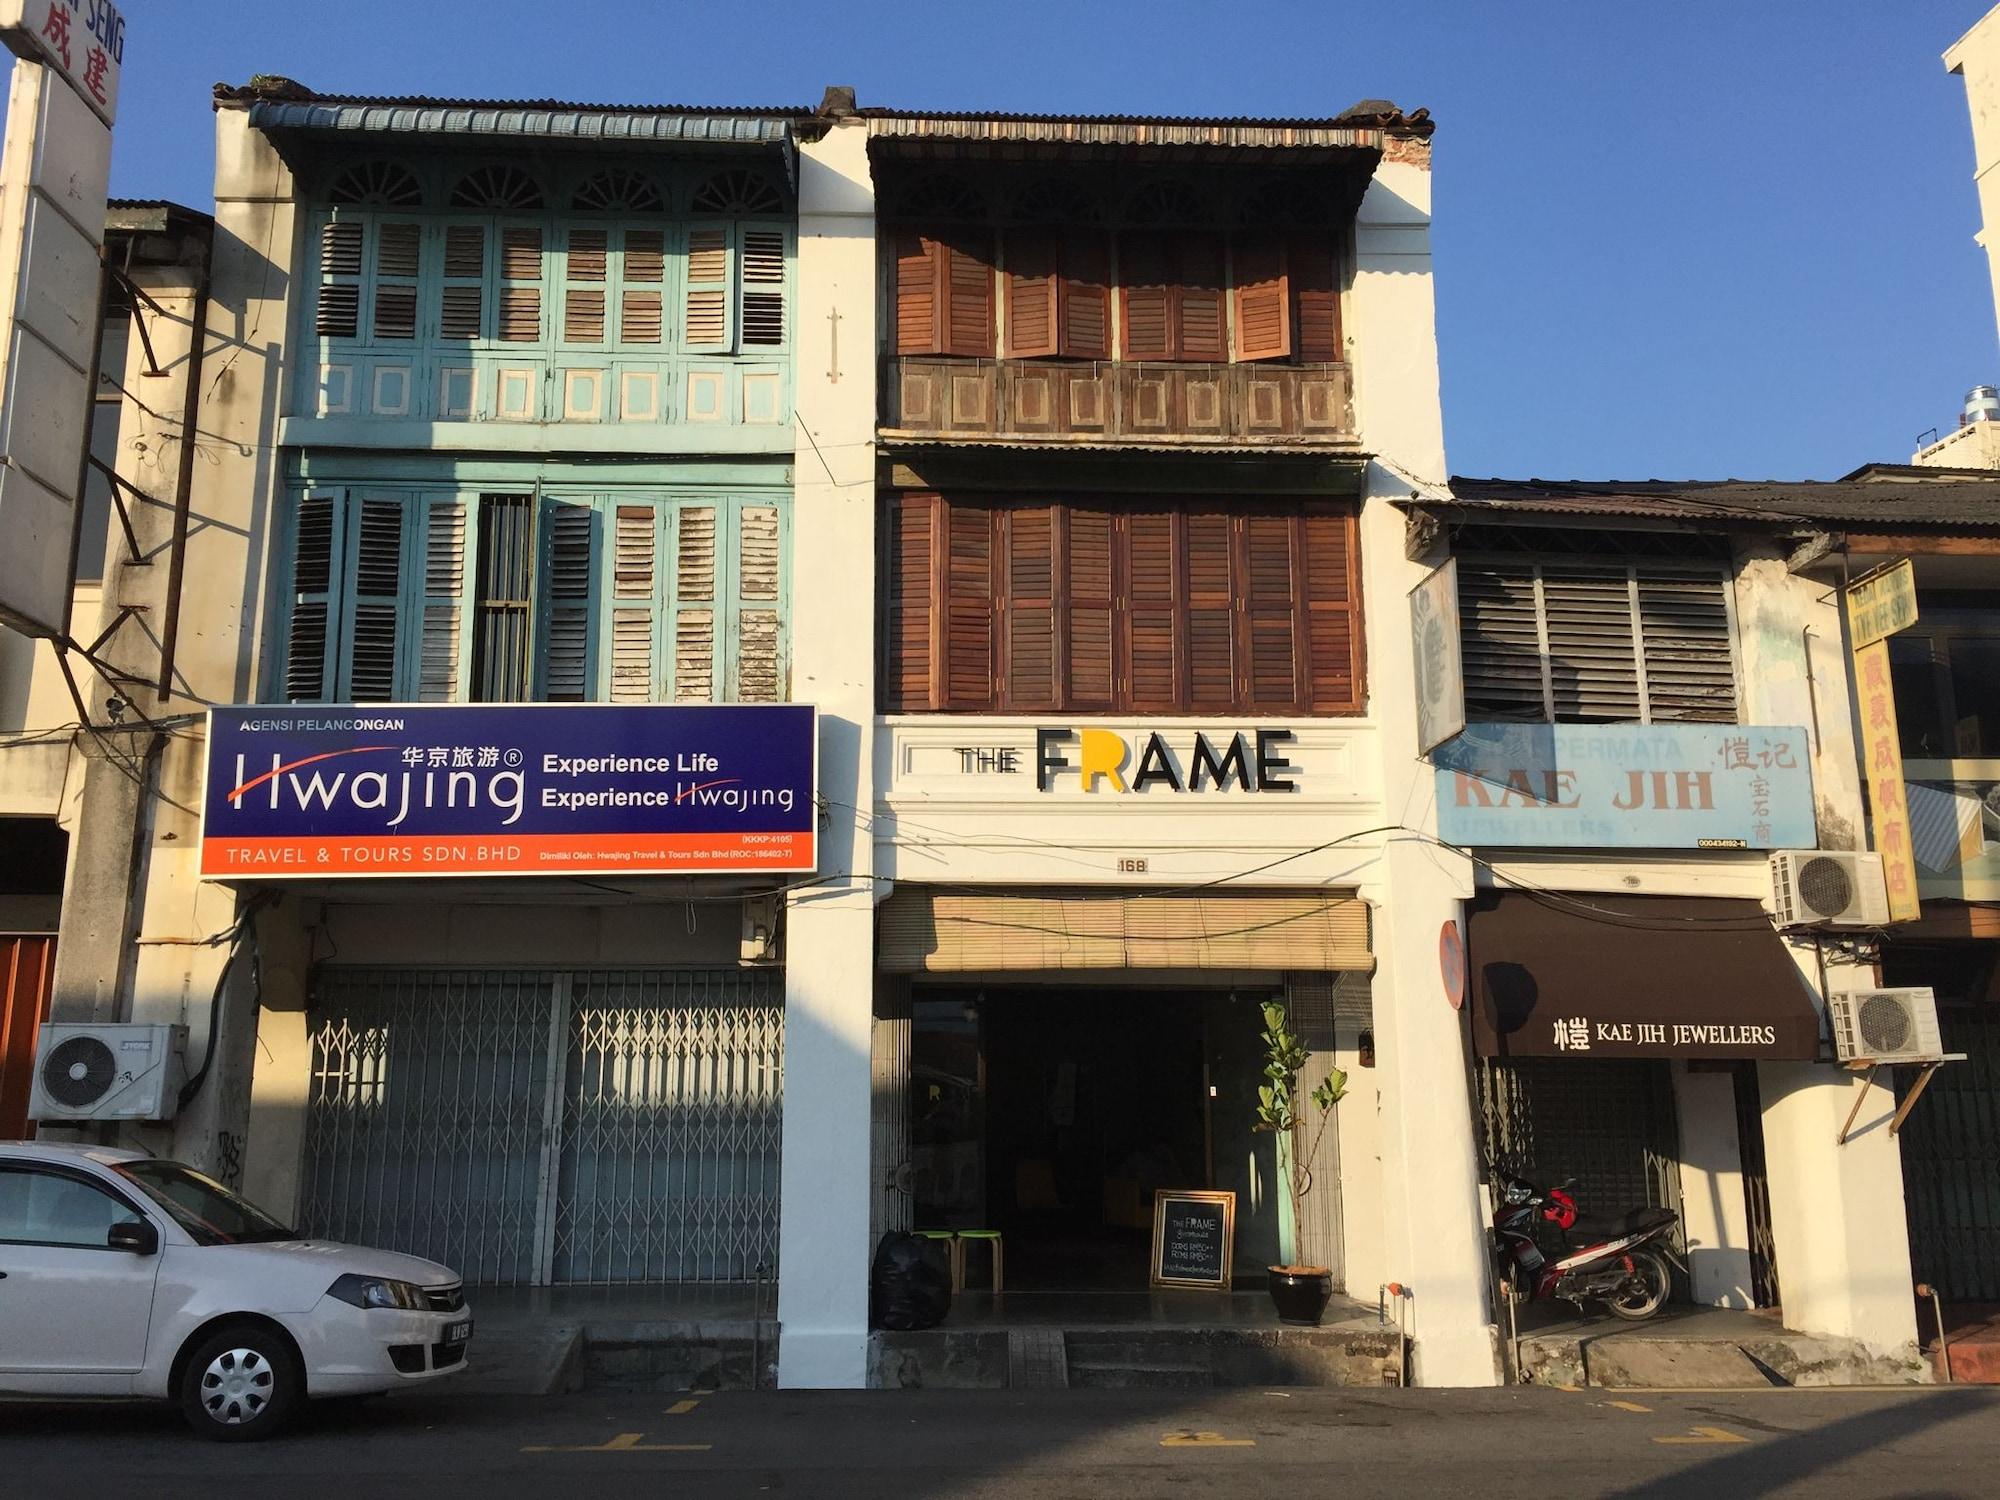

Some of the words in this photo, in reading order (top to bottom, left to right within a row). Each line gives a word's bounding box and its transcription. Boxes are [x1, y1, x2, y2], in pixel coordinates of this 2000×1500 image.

[240, 719, 293, 731] AGENSI
[297, 718, 404, 731] PELANCONGAN
[543, 754, 670, 777] Experience
[677, 753, 719, 772] Life
[953, 747, 1018, 774] THE
[1036, 727, 1296, 793] FRAME
[231, 752, 525, 826] Hwajing
[542, 788, 669, 811] Experience
[675, 781, 794, 813] Hwajing
[1455, 768, 1582, 809] KAE
[1612, 769, 1717, 811] JIH
[1748, 774, 1772, 844] 宝石商
[226, 848, 306, 864] TRAVEL
[316, 848, 330, 863] &
[341, 847, 412, 862] TOURS
[597, 851, 630, 861] Hwajing
[633, 850, 658, 860] Travel
[659, 850, 666, 859] &
[668, 850, 691, 859] Tours
[693, 850, 709, 859] Sdn
[711, 849, 729, 859] Bhd
[1119, 859, 1147, 873] 168
[1596, 1023, 1633, 1041] KAE
[1636, 1024, 1666, 1046] JIH
[1672, 1024, 1776, 1046] JEWELLERS
[1185, 1217, 1217, 1231] FRAME
